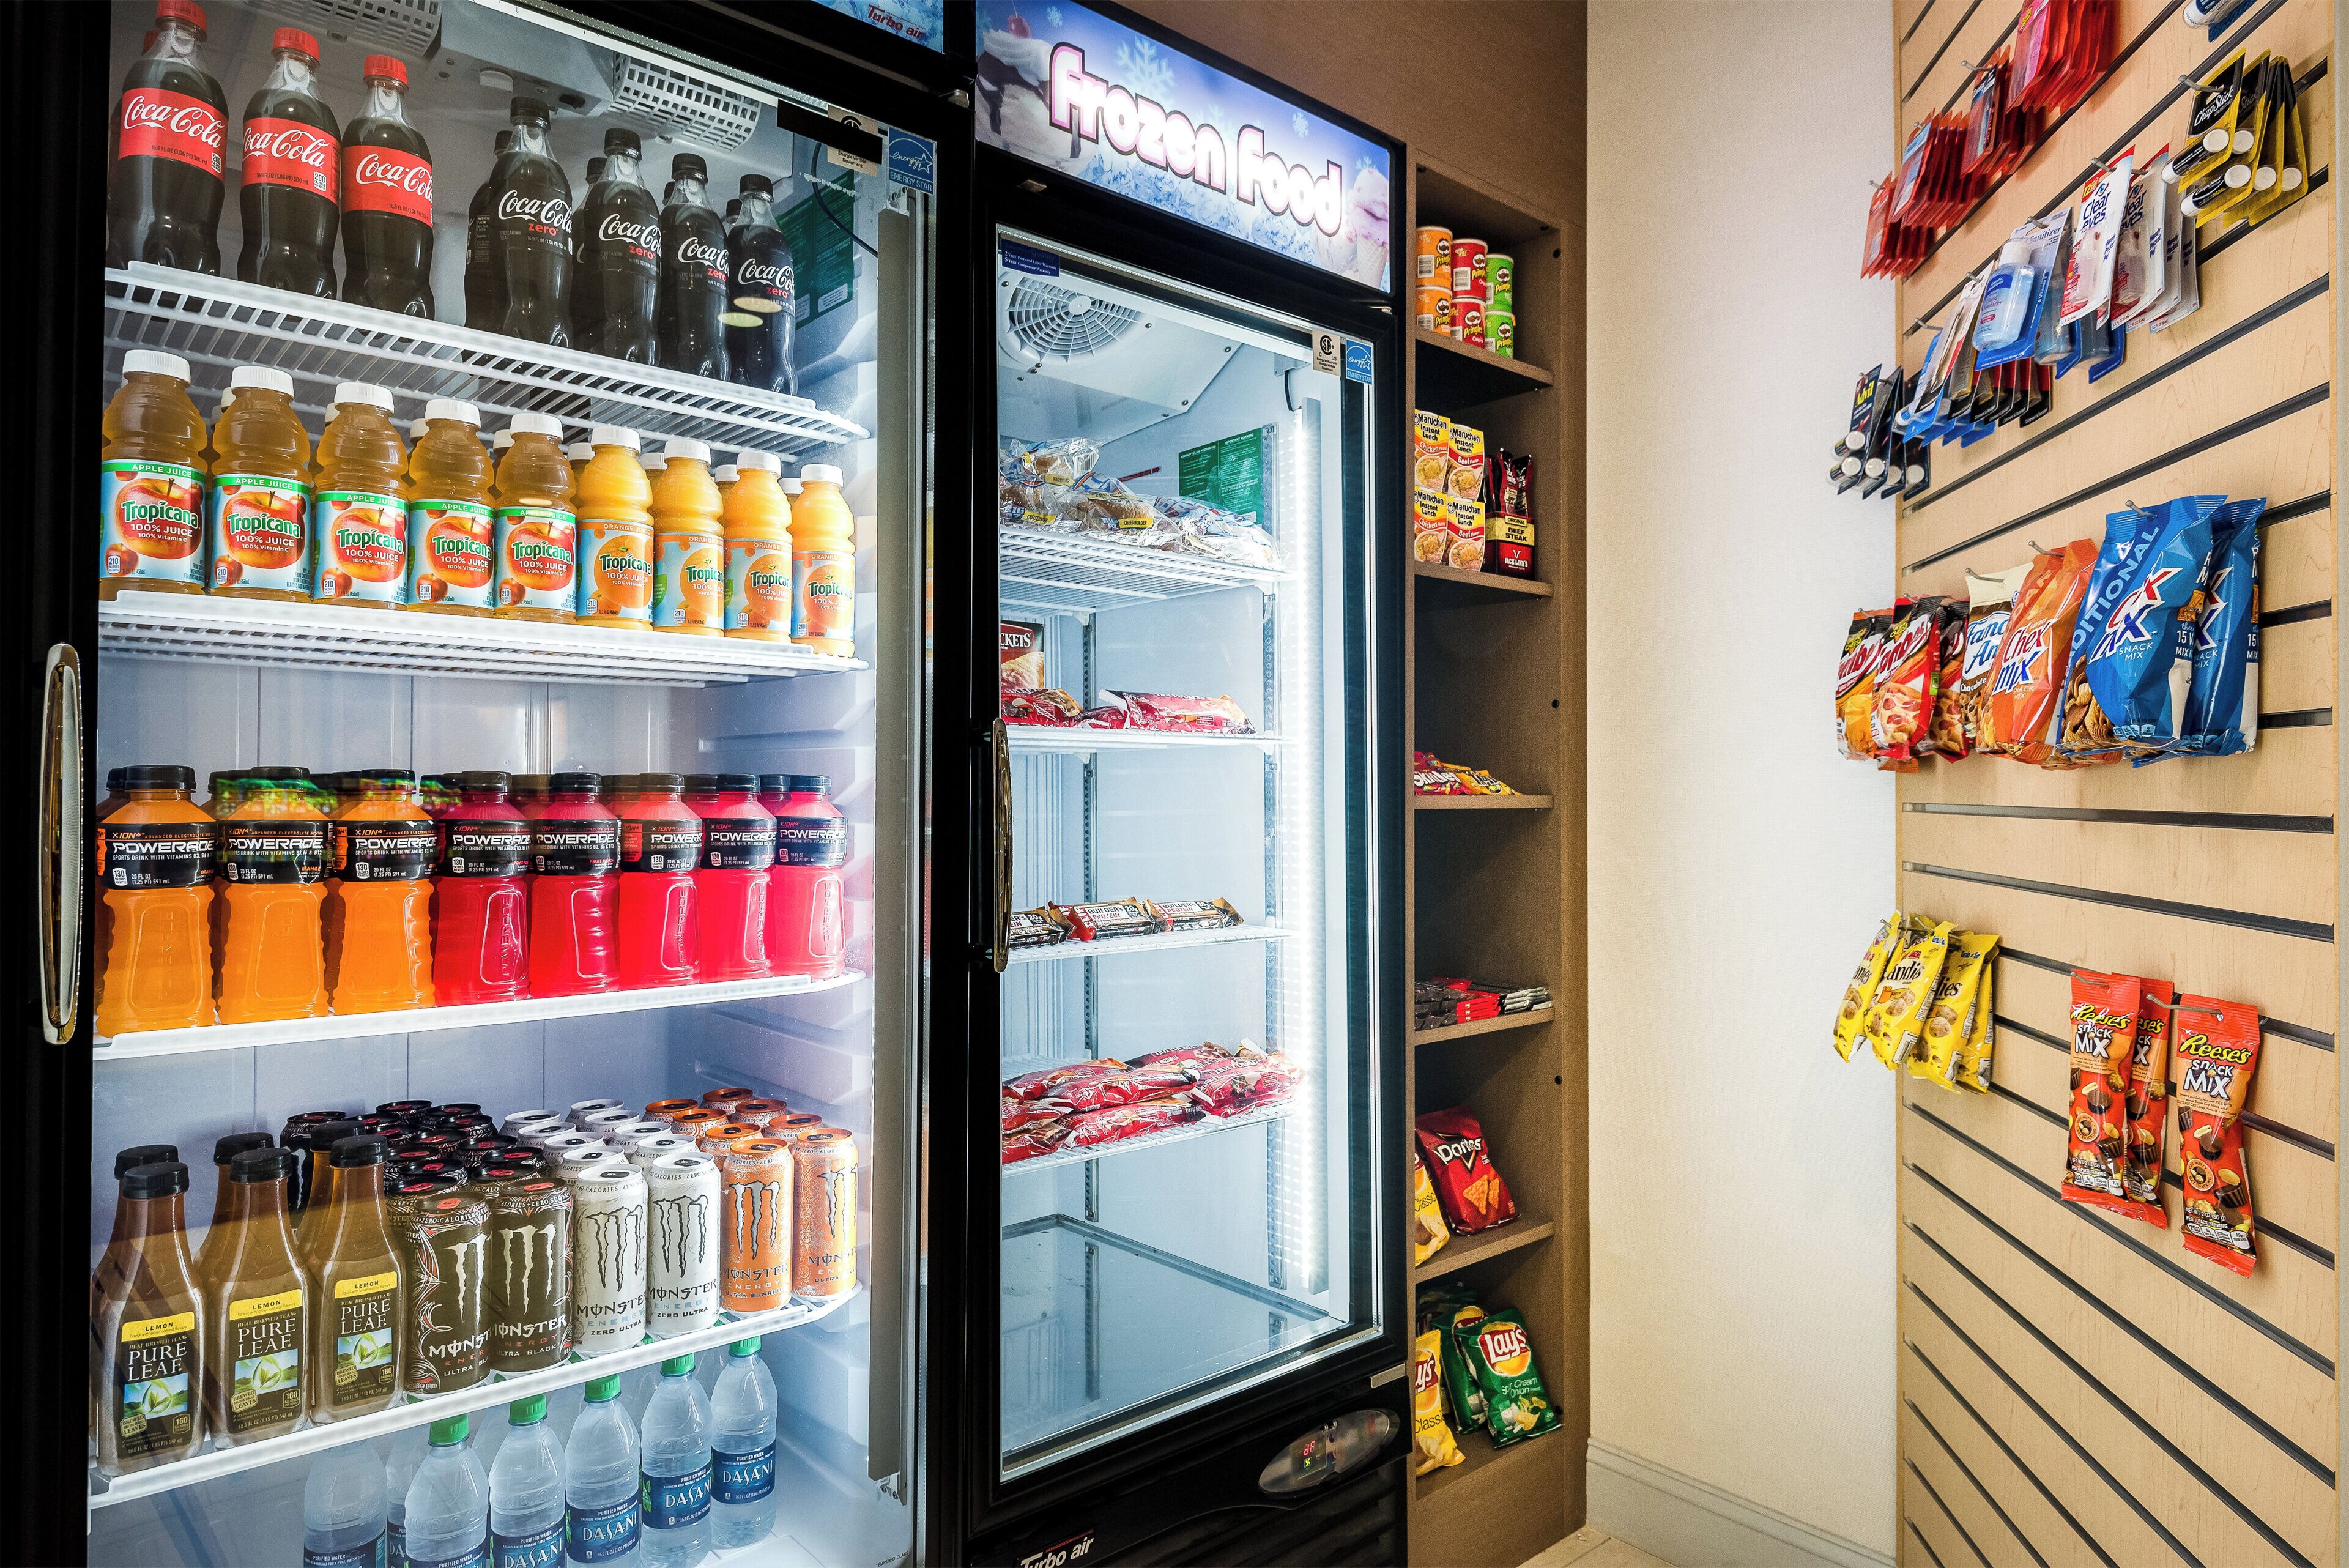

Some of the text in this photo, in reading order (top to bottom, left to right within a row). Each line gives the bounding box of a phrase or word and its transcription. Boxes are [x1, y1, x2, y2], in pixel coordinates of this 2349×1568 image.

[868, 4, 903, 31] Turbo
[905, 26, 927, 39] air
[2194, 85, 2234, 127] ChapStick
[124, 95, 225, 148] Coca-Cola
[1049, 42, 1343, 237] frozen food
[242, 127, 330, 169] Coca-Cola
[314, 173, 325, 182] 200
[355, 154, 432, 203] Coca-Cola
[890, 172, 932, 191] ENERGY STAR
[498, 190, 573, 233] Coca-Cola
[2083, 190, 2111, 219] Clear
[528, 223, 558, 236] zero
[599, 214, 661, 257] Coca-Col
[629, 245, 655, 259] zero
[707, 267, 727, 281] zero
[766, 286, 789, 298] zero
[1464, 326, 1482, 338] Pringles
[1348, 371, 1362, 379] ENERGY
[1417, 413, 1447, 429] Maruchan
[1420, 426, 1440, 435] Instant
[1422, 432, 1438, 441] Lunch
[1452, 428, 1480, 442] Maruchan
[1420, 442, 1439, 452] Chicken
[132, 464, 192, 478] APPLE JUICE
[122, 500, 199, 529] Tropicana
[1453, 502, 1481, 515] Maruchan
[164, 526, 193, 537] JUICE
[227, 513, 301, 539] Tropicana
[337, 529, 403, 554] Tropicana
[1505, 533, 1526, 541] STEAK
[432, 537, 492, 560] Tropicana
[512, 541, 571, 563] Tropicana
[599, 554, 651, 575] Tropicana
[630, 574, 648, 583] JUICE
[808, 582, 853, 600] Tropicana
[1890, 622, 1909, 638] CHEESE
[2003, 625, 2047, 662] Chex
[2119, 642, 2153, 656] SNACK
[2124, 650, 2143, 660] MIX
[1961, 677, 1987, 692] Chocolate
[536, 833, 615, 844] POWERADE
[780, 830, 845, 839] POWERADE
[113, 840, 214, 853] POWERADE
[229, 838, 322, 850] POWERADE
[2179, 1034, 2252, 1064] Reese's
[1438, 1138, 1482, 1162] Doritos
[341, 1299, 390, 1320] PURE
[655, 1298, 710, 1310] ENERGY
[682, 1306, 708, 1317] ULTRA
[146, 1322, 173, 1331] LEMON
[239, 1318, 296, 1343] PURE
[341, 1313, 387, 1334] LEAF
[239, 1334, 292, 1358] LEAF
[527, 1345, 557, 1356] BLACK
[1484, 1327, 1527, 1364] Lay's
[128, 1342, 187, 1365] PURE
[128, 1358, 182, 1381] LEAF
[1514, 1377, 1537, 1388] Cream
[233, 1391, 255, 1402] BREWED
[1510, 1388, 1529, 1398] Onion
[235, 1399, 256, 1410] LEAVES
[723, 1460, 773, 1486] DASANI
[598, 1507, 617, 1516] PURIFIED
[582, 1510, 637, 1542] DASANI
[1071, 1537, 1094, 1559] air
